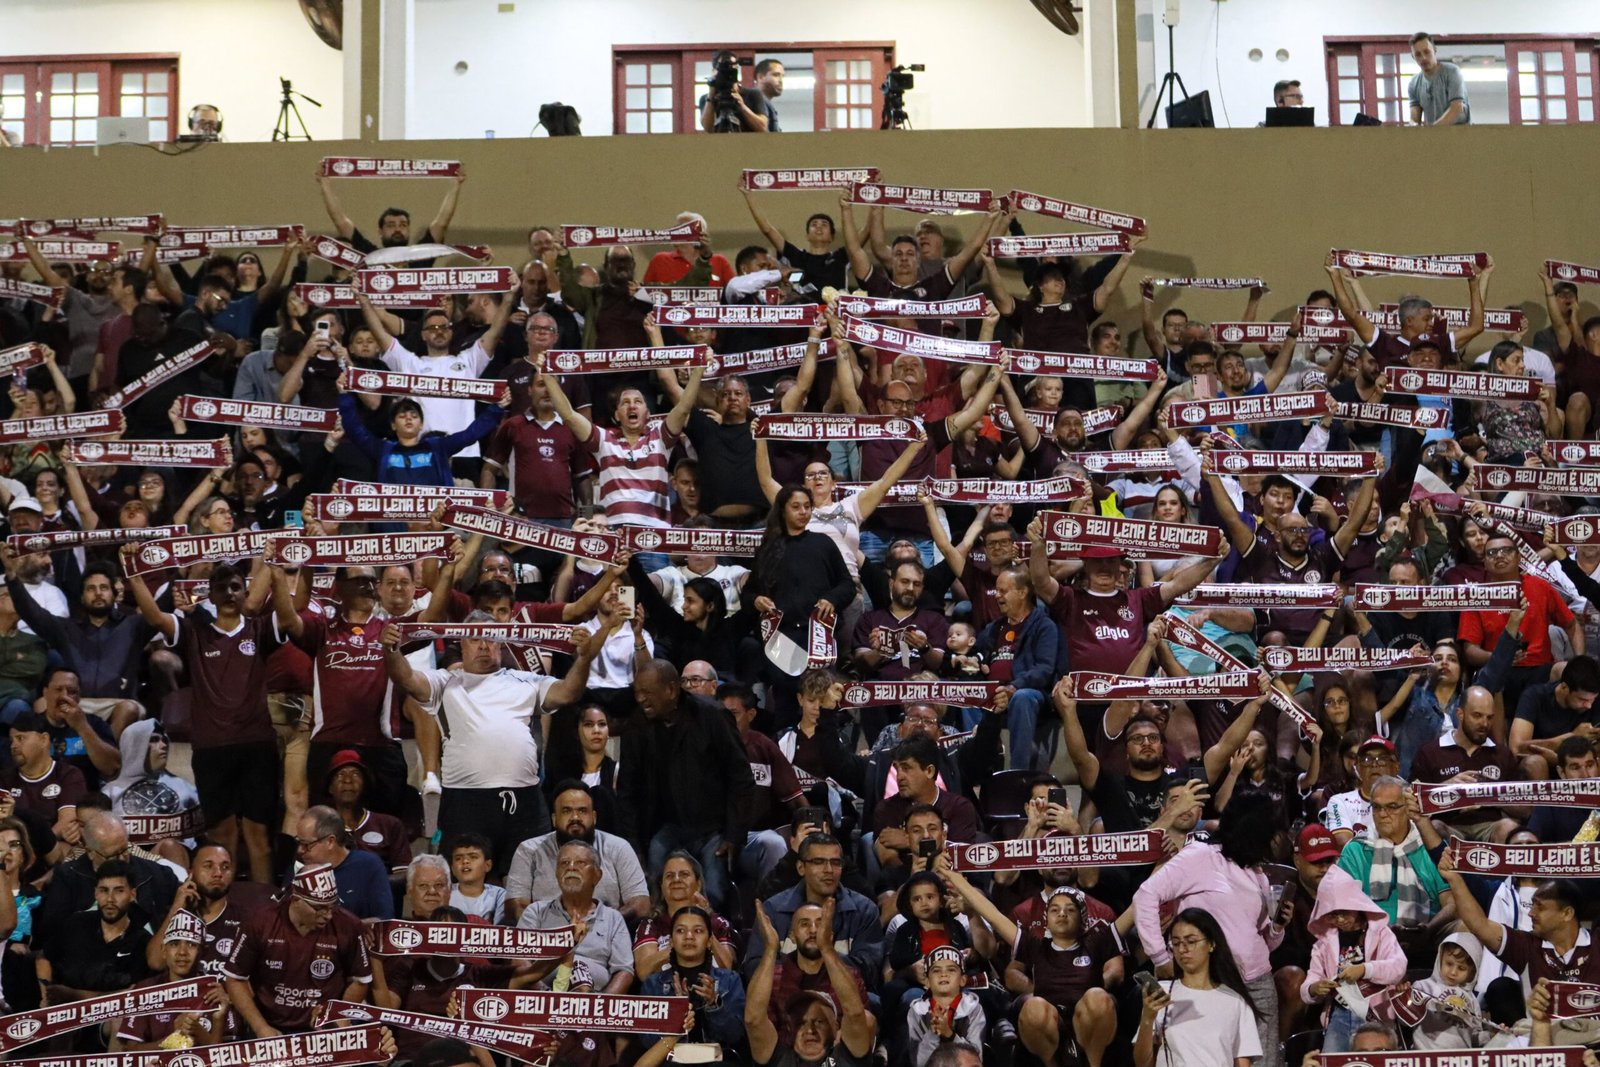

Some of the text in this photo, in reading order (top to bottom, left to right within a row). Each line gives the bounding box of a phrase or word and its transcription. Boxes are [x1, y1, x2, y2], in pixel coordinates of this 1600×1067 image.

[769, 423, 812, 436] VENCER
[454, 512, 500, 533] VENCER
[1086, 520, 1109, 536] SEU
[1114, 523, 1145, 539] LEMA
[1160, 527, 1208, 545] VENCER
[172, 541, 198, 557] SEU
[201, 538, 235, 556] LEMA
[1149, 540, 1158, 548] da
[1159, 541, 1180, 550] Sorte
[1096, 626, 1129, 640] anglo
[326, 650, 383, 668] Damha
[874, 686, 896, 699] SEU
[900, 686, 929, 699] LEMA
[943, 686, 986, 700] VENCER
[150, 817, 180, 834] LEMA
[1004, 840, 1032, 857] SEU
[1037, 838, 1075, 856] LEMA
[1092, 835, 1148, 854] VENCER
[1079, 854, 1090, 863] da
[1091, 853, 1116, 863] Sorte
[1506, 850, 1533, 865] SEU
[1538, 850, 1576, 865] LEMA
[307, 870, 336, 892] LEM
[428, 928, 456, 944] SEU
[461, 928, 499, 945] LEMA
[517, 929, 574, 946] VENCER
[503, 946, 514, 955] da
[516, 946, 541, 955] Sorte
[48, 1008, 76, 1026] SEU
[81, 1000, 120, 1019] LEMA
[139, 984, 198, 1009] VENCER
[124, 1009, 136, 1018] da
[138, 1002, 164, 1013] Sorte
[514, 996, 544, 1015] SEU
[549, 997, 589, 1016] LEMA
[609, 999, 668, 1020] VENCER
[594, 1017, 606, 1027] da
[607, 1018, 634, 1028] Sorte
[473, 1026, 535, 1047] VENCER
[209, 1046, 239, 1066] SEU
[244, 1040, 286, 1062] LEMA
[306, 1029, 367, 1056] VENCER
